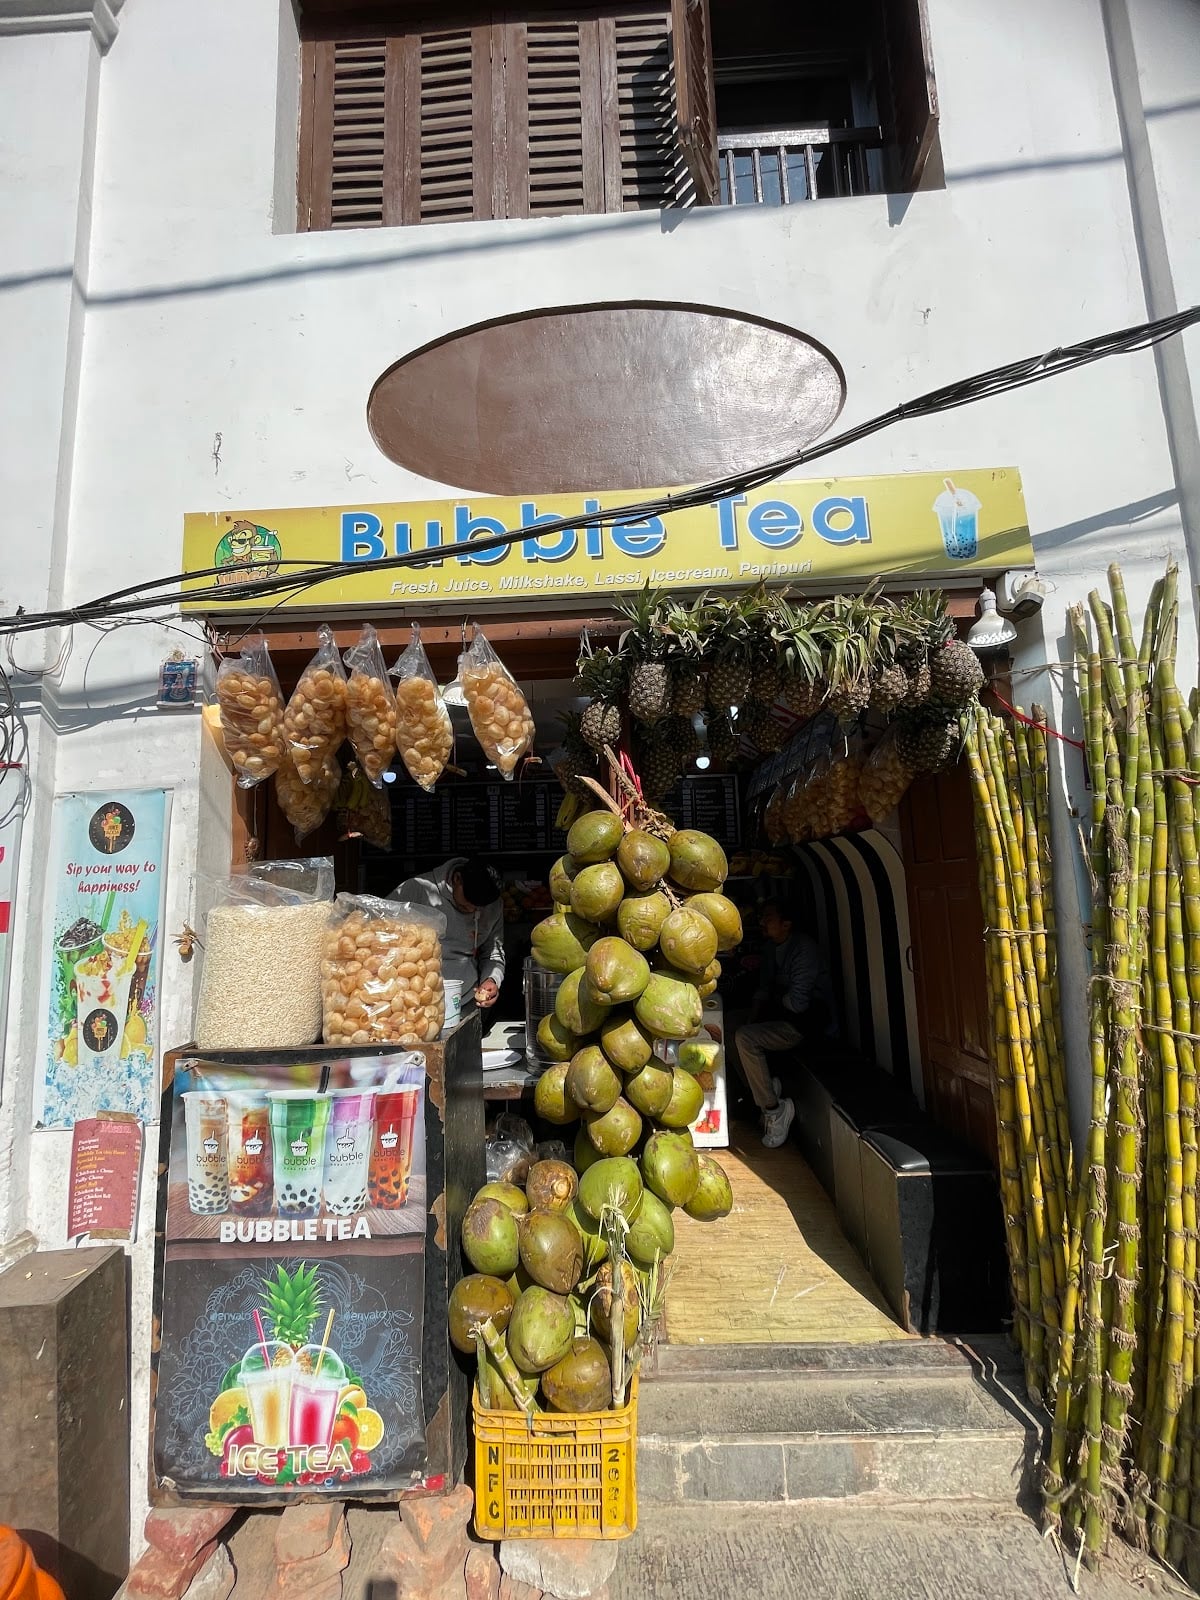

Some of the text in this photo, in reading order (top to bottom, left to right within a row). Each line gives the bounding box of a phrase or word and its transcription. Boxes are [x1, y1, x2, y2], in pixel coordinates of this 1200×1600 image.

[340, 492, 871, 566] Bubble Tea
[390, 560, 812, 594] Fresh Juice, Milkshake, Lassi, Icecream, Panipuri
[66, 861, 156, 877] Sip your way to
[78, 880, 141, 895] happiness!
[196, 1153, 226, 1163] bubble
[284, 1156, 317, 1166] bubble
[329, 1152, 364, 1162] bubble
[219, 1217, 371, 1243] BUBBLE TEA
[227, 1443, 353, 1476] ICE TEA
